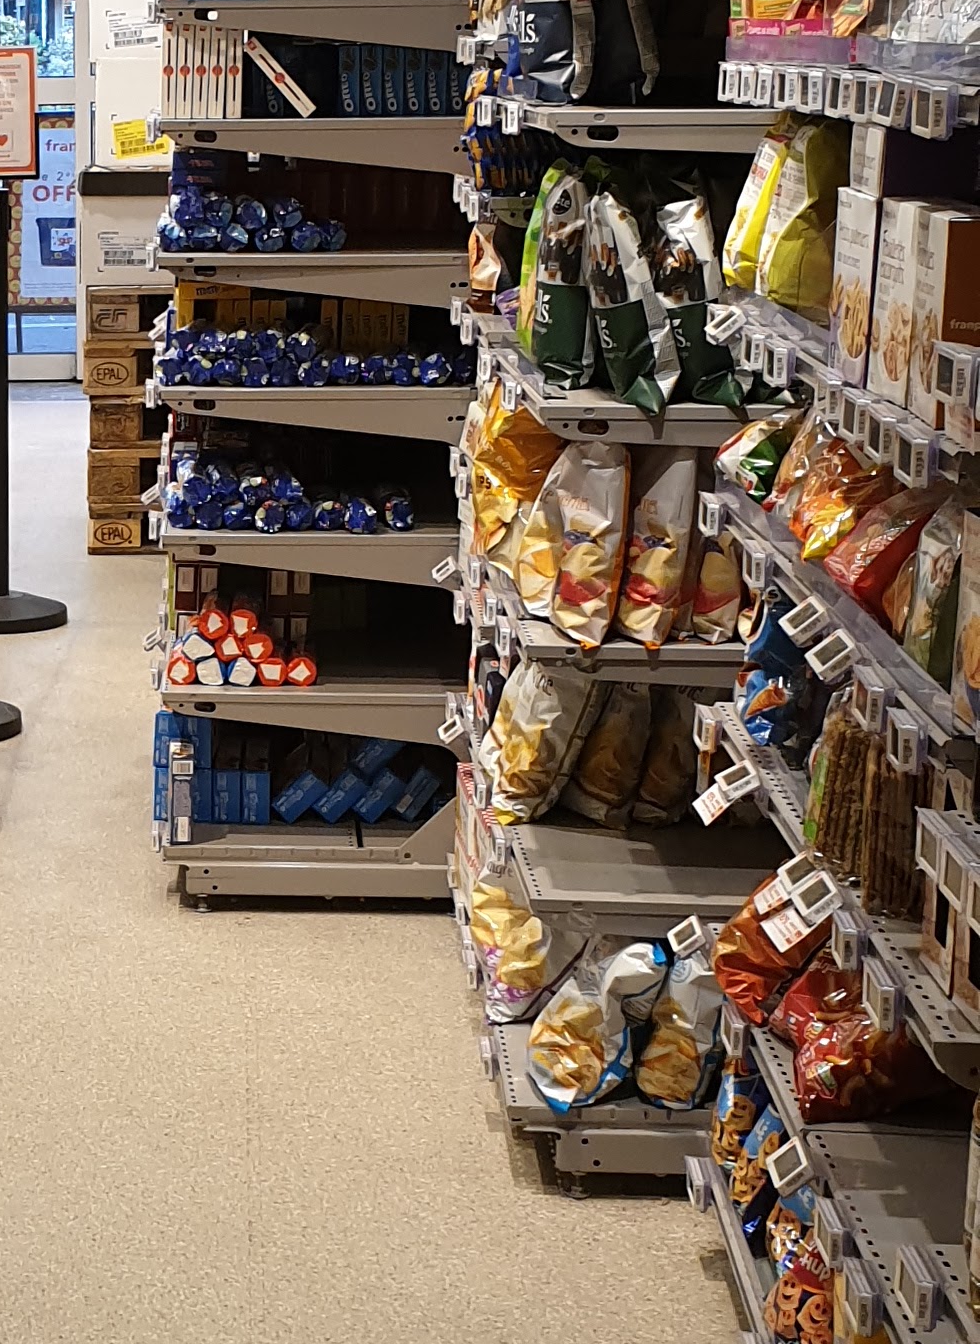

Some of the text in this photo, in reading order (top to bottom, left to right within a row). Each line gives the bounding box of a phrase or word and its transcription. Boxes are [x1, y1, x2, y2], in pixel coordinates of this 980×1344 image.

[341, 71, 354, 113] OREO
[363, 71, 376, 113] OREO
[385, 71, 397, 113] OREO
[406, 71, 418, 113] OREO
[96, 366, 123, 382] EPAL
[101, 526, 126, 542] EPAL
